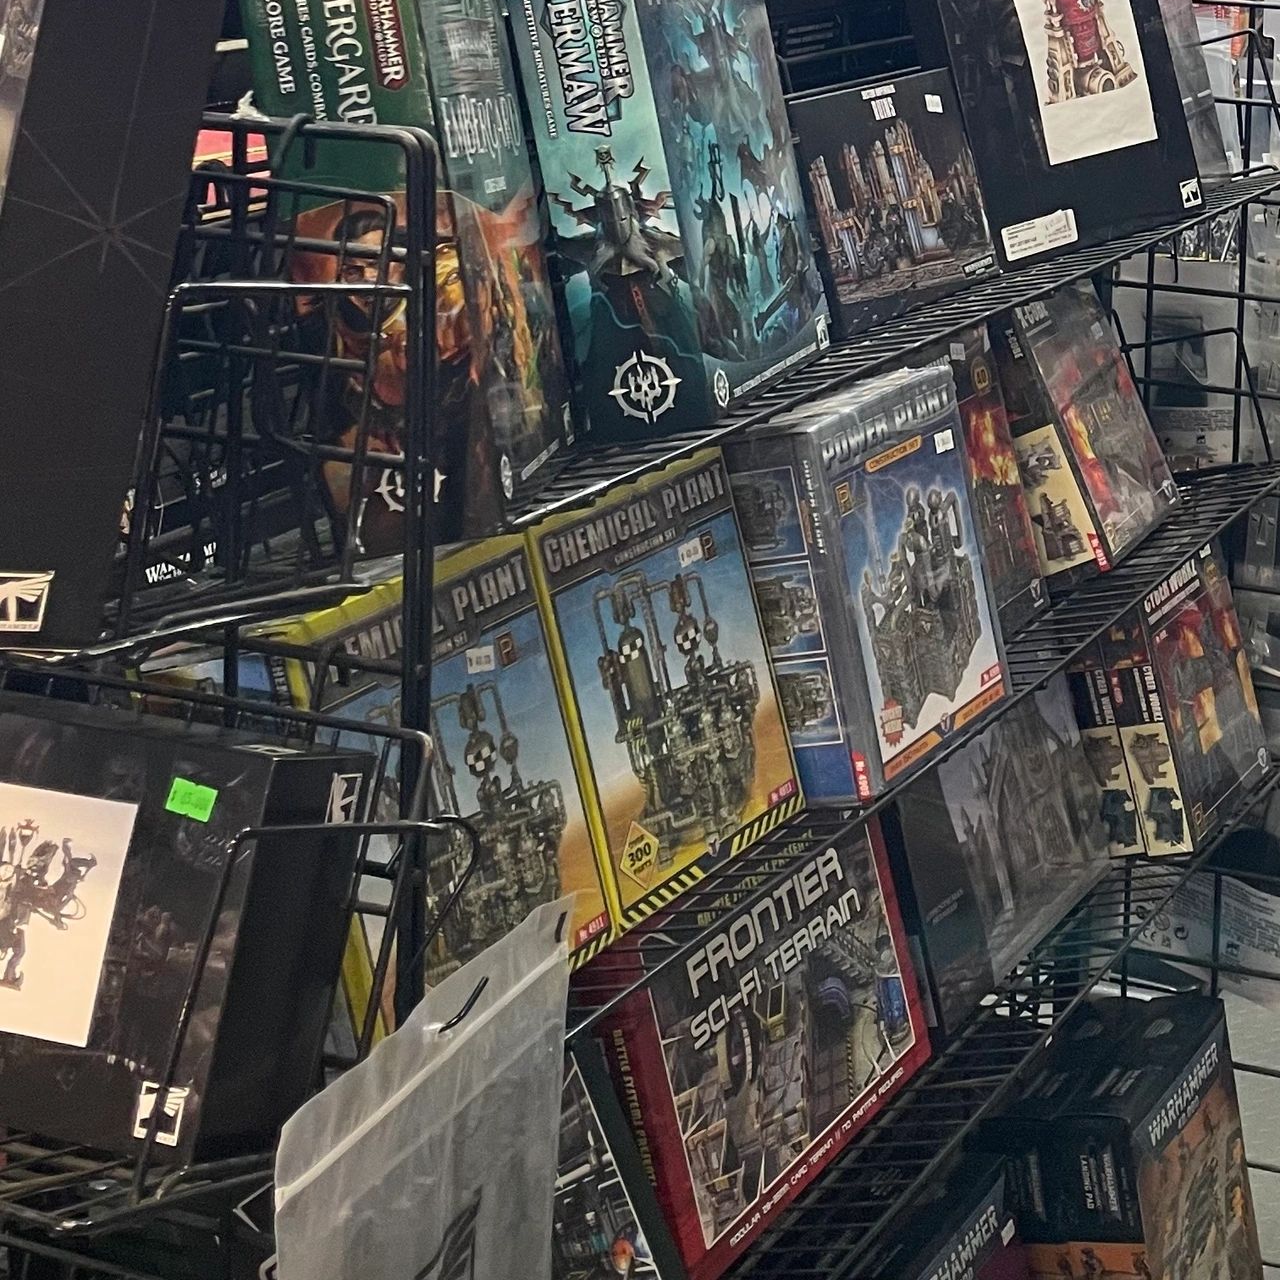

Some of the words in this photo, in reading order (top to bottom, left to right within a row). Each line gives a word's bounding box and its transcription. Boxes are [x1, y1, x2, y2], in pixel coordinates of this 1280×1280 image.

[272, 40, 296, 95] GAME
[532, 48, 552, 114] MINIATURES
[546, 107, 559, 139] GAME
[820, 412, 889, 471] POWER
[893, 384, 949, 432] PLANT
[543, 499, 657, 574] CHEMICAL
[661, 462, 726, 519] PLANT
[452, 555, 529, 620] PLANT
[627, 841, 652, 867] 300
[685, 847, 844, 999] FRONTIER
[689, 969, 763, 1051] SCI-FI
[765, 887, 862, 981] TERRAIN
[1148, 1042, 1220, 1148] WARHAMMER
[729, 1212, 761, 1247] MODULAR
[790, 1164, 808, 1185] CARD
[809, 1137, 834, 1166] TERRAIN
[841, 1120, 852, 1133] NO
[1079, 1153, 1094, 1191] LANDING
[1085, 1191, 1096, 1210] PAD
